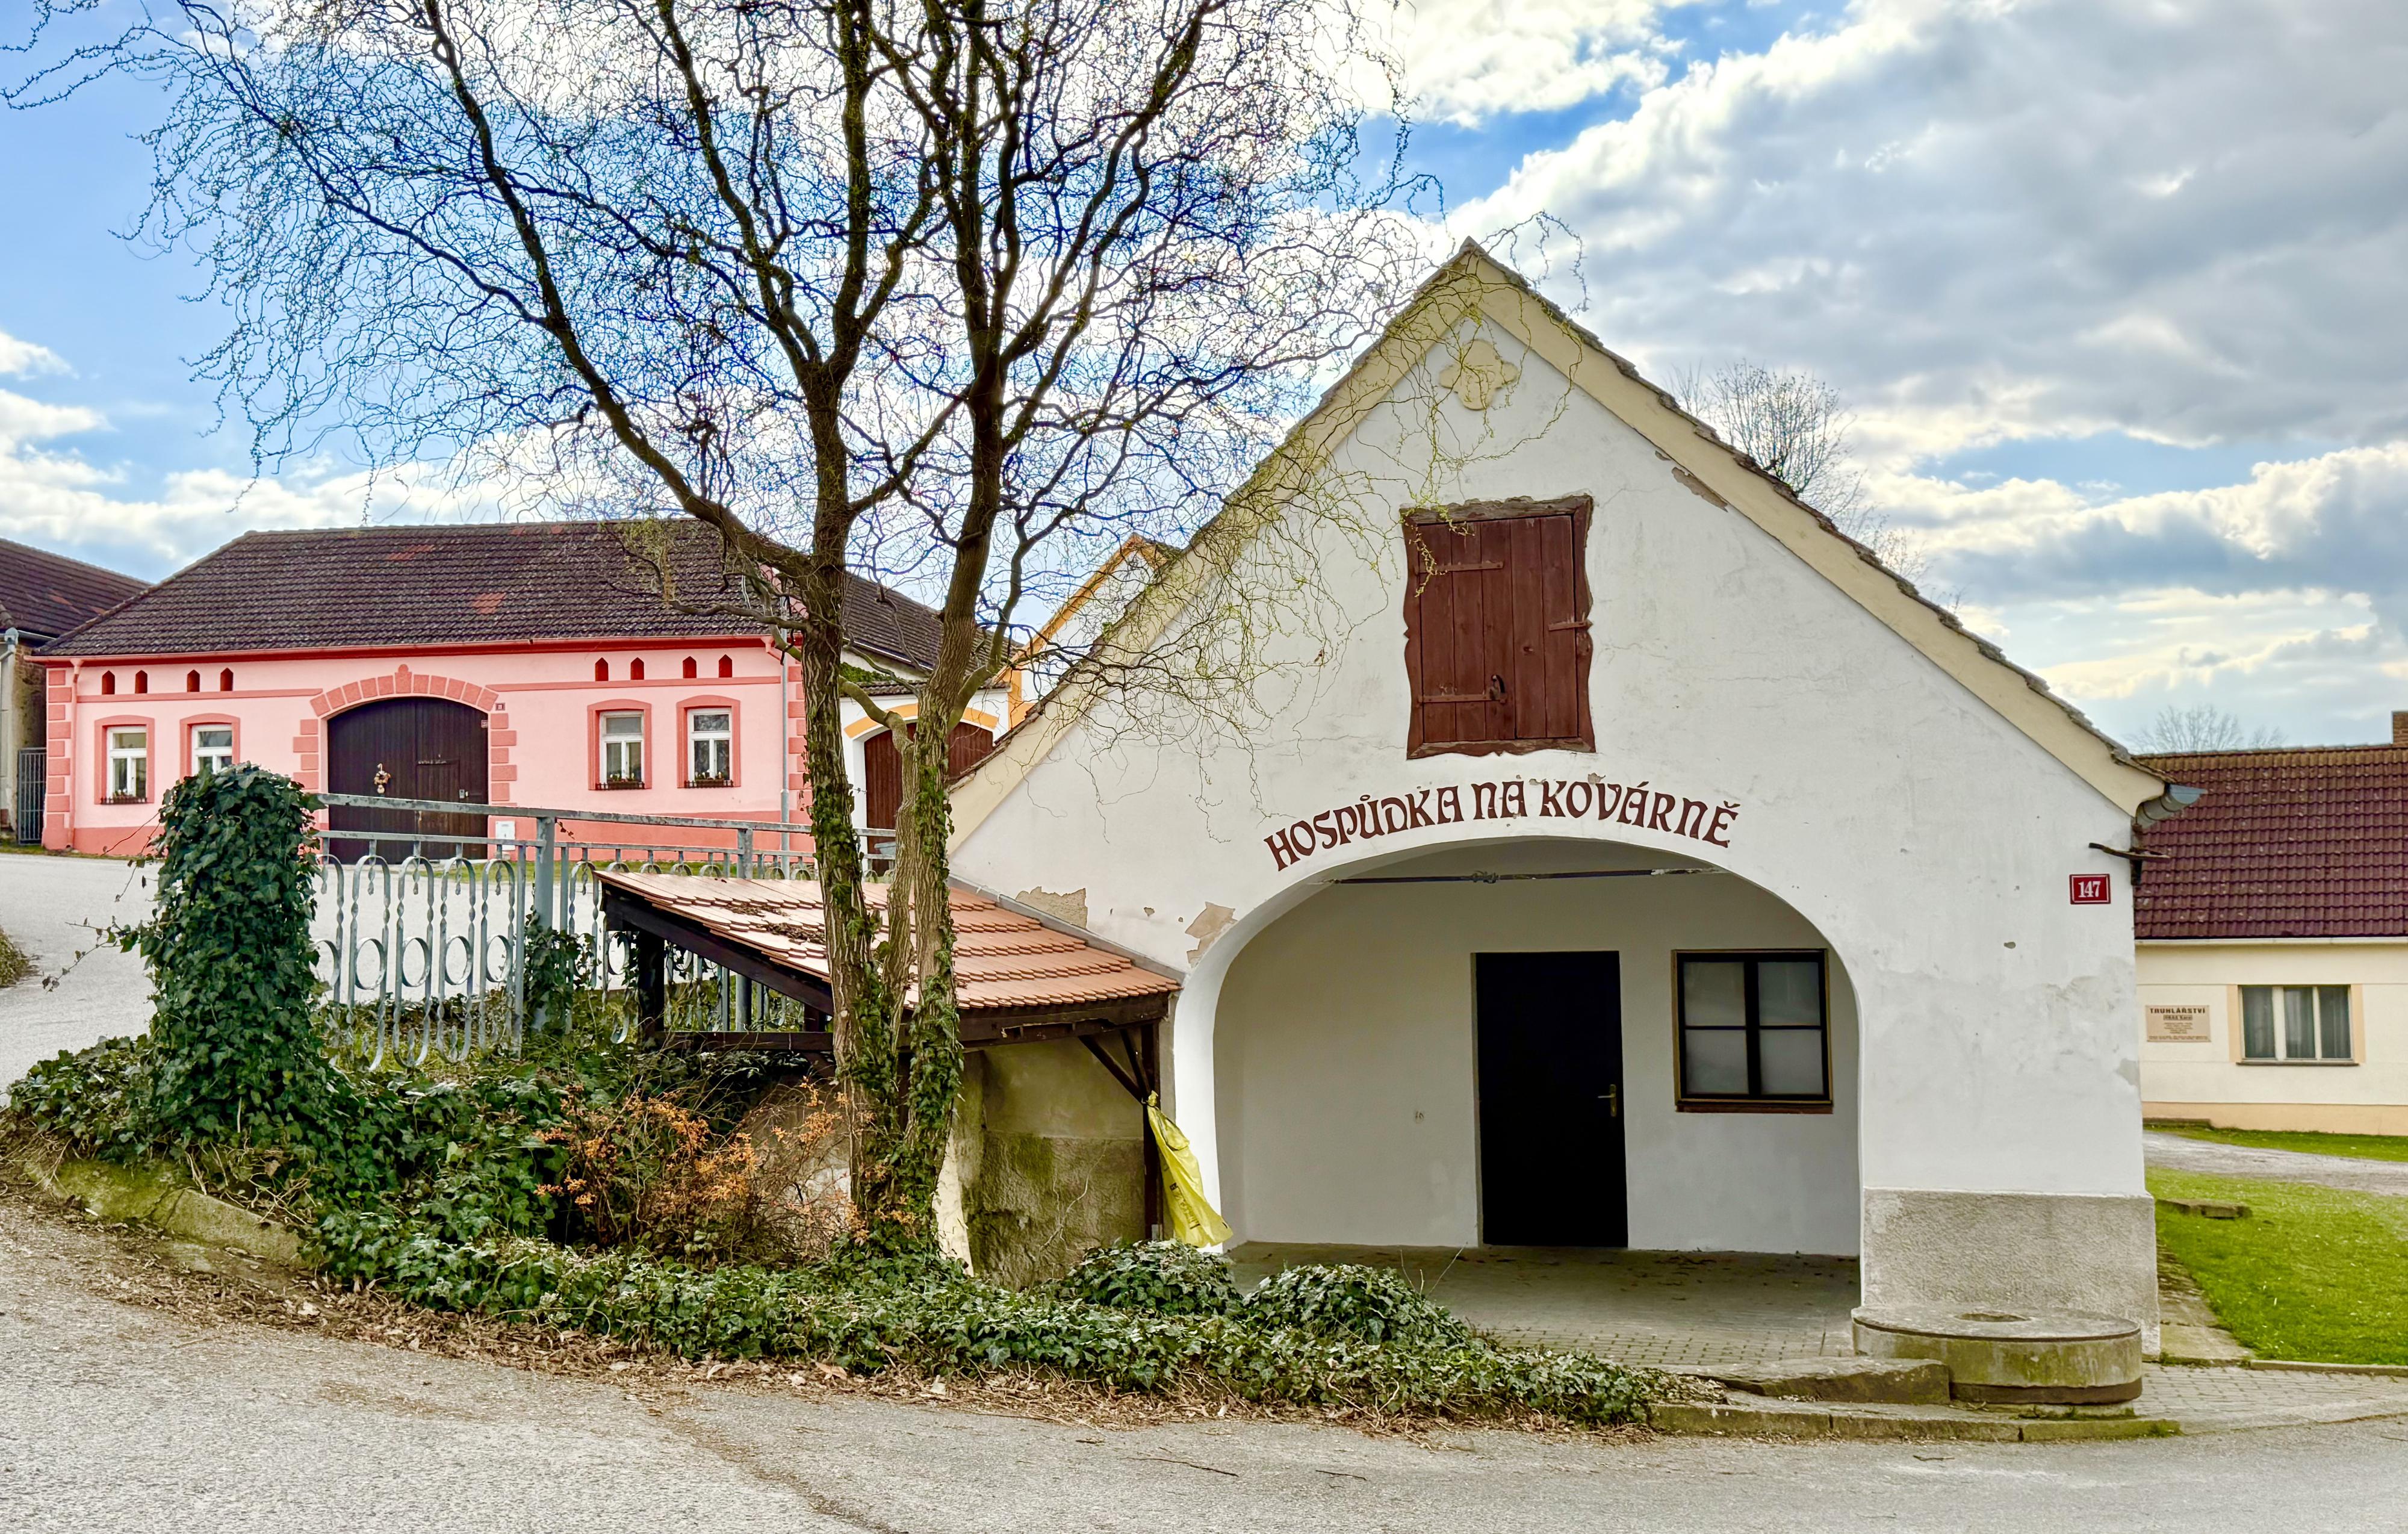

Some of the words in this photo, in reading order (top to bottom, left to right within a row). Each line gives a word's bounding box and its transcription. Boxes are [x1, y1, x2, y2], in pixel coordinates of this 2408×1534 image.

[1264, 785, 1464, 872] HOSPŮDKA
[1471, 781, 1527, 820] NA
[1540, 780, 1739, 849] KOVÁRNĚ
[2078, 880, 2101, 898] 147
